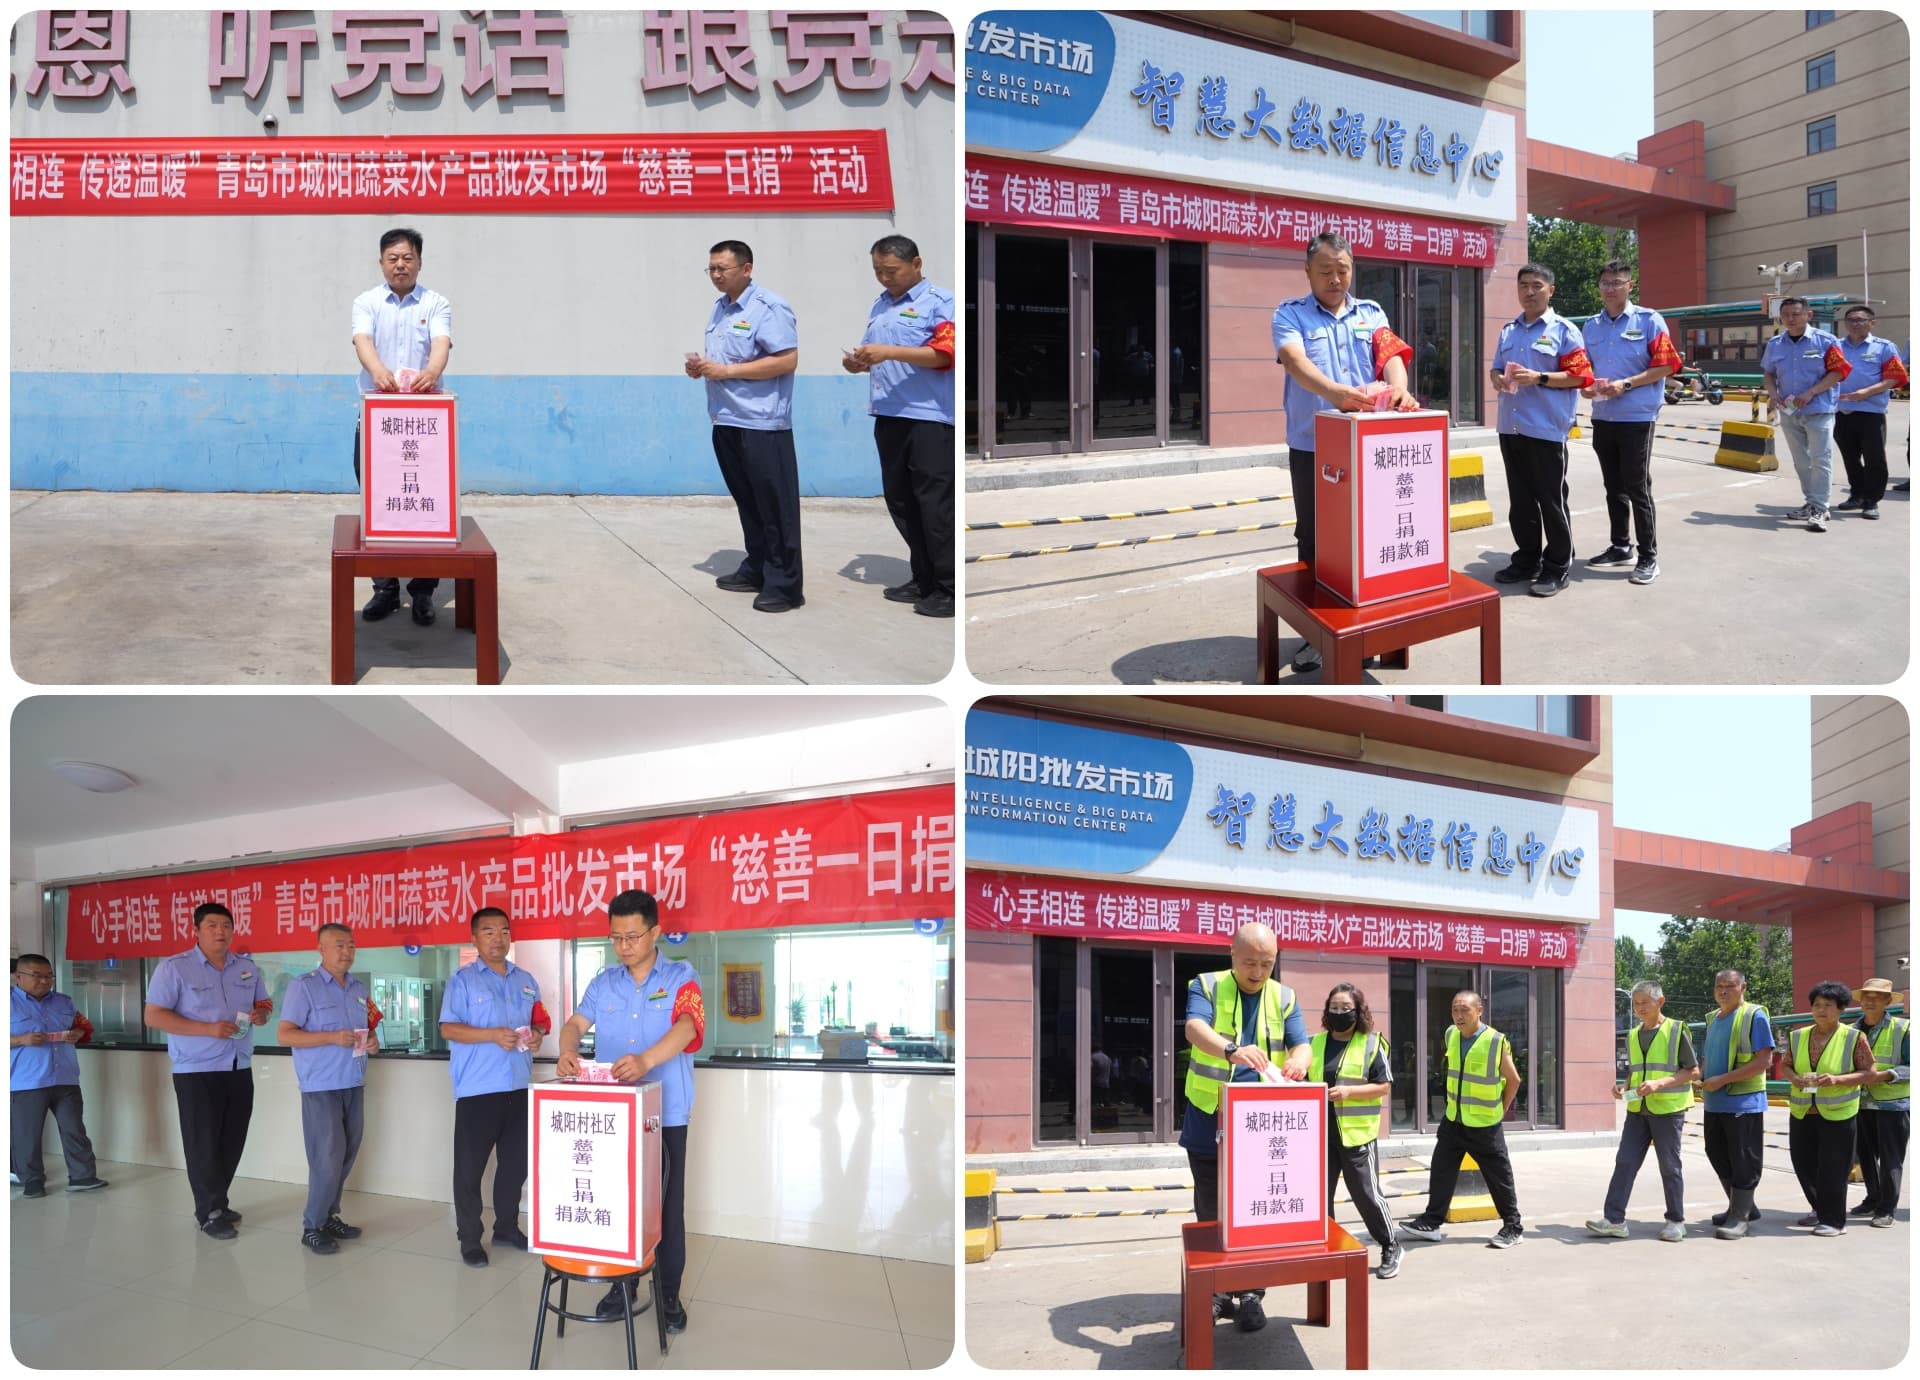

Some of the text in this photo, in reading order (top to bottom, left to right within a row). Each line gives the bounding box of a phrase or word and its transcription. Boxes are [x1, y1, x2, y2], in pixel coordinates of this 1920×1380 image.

[977, 84, 1040, 105] CENTER
[982, 69, 992, 82] &
[999, 73, 1026, 88] BIG
[1034, 80, 1070, 97] DATA
[1130, 58, 1504, 183] 智慧大数据信息中心
[13, 152, 65, 200] 相连
[381, 416, 438, 436] 城阳村社区
[1374, 444, 1433, 470] 城阳村社区
[386, 496, 435, 512] 捐款箱
[1379, 539, 1429, 564] 捐款箱
[965, 745, 1174, 801] 城阳批发市场
[1073, 817, 1127, 832] CENTER
[1077, 803, 1086, 814] &
[1092, 806, 1115, 819] BIG
[1121, 809, 1153, 823] DATA
[1206, 783, 1585, 883] 智慧大数据信息中心
[551, 1110, 616, 1135] 城阳村社区
[1245, 1111, 1309, 1133] 城阳村社区
[555, 1204, 611, 1226] 捐款箱
[1250, 1198, 1304, 1216] 捐款箱
